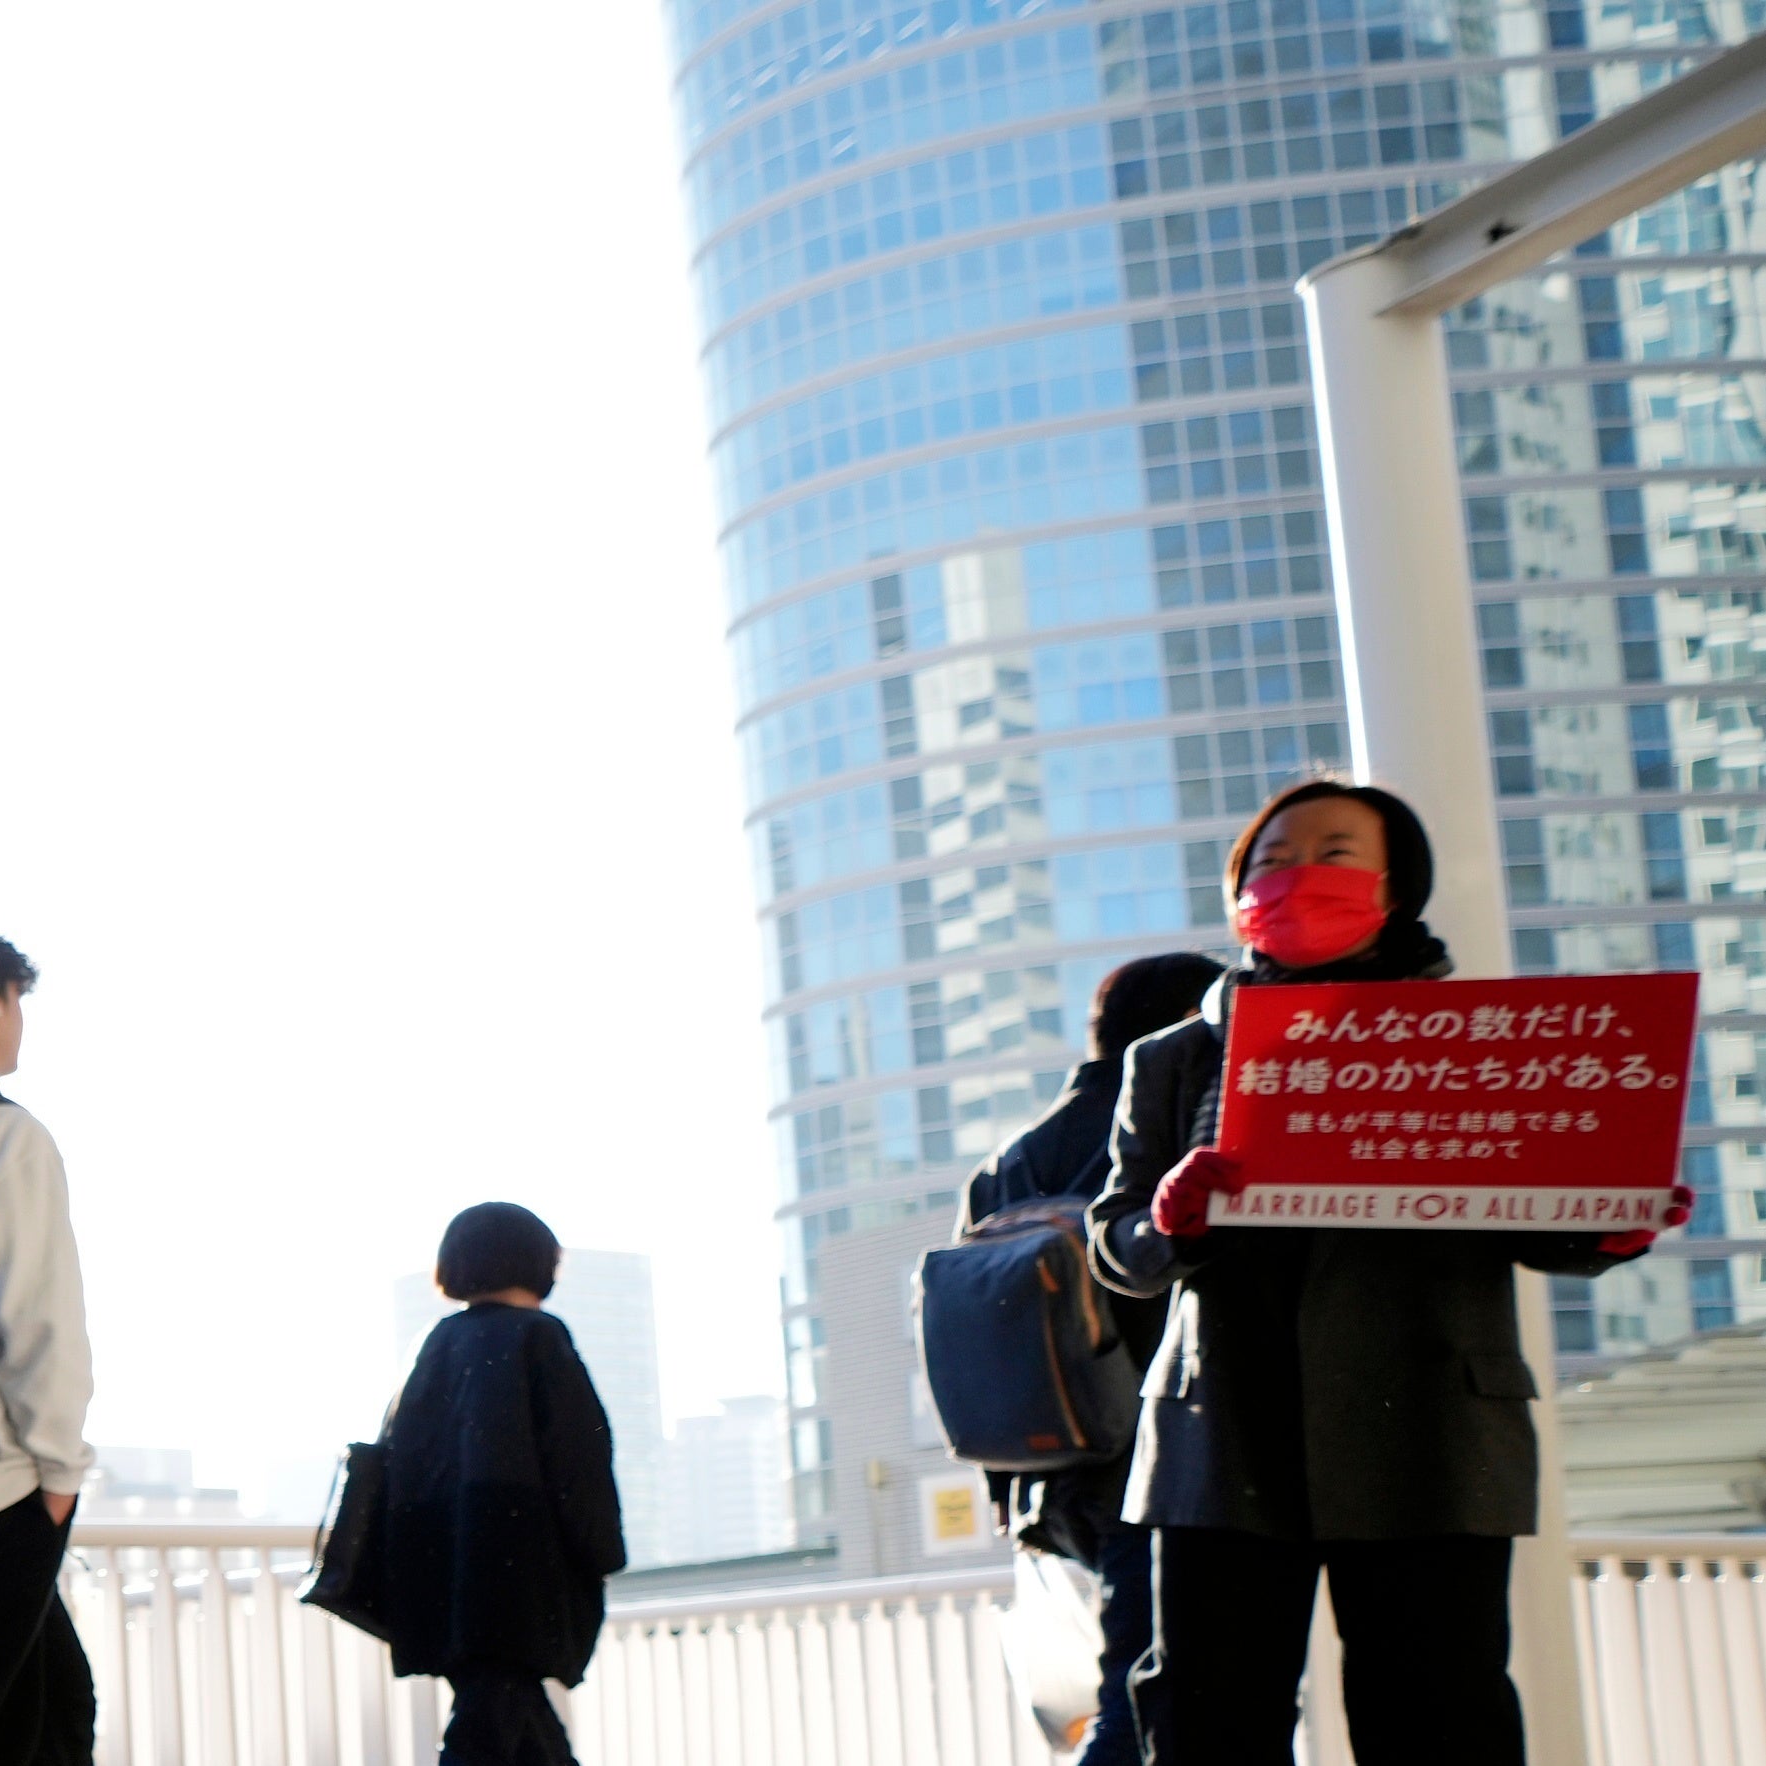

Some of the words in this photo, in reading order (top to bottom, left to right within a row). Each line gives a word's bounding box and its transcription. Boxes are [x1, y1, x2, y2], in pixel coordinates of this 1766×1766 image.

[1283, 1004, 1634, 1043] みんなの数だけ、
[1236, 1052, 1680, 1096] 結婚のかたちがある。
[1285, 1110, 1600, 1135] 誰もが平等に結婚できる
[1350, 1138, 1524, 1161] 社会を求めて
[1223, 1194, 1377, 1219] MARRIAGE
[1395, 1194, 1469, 1221] FOR
[1484, 1196, 1538, 1221] ALL
[1550, 1196, 1656, 1222] JAPAN
